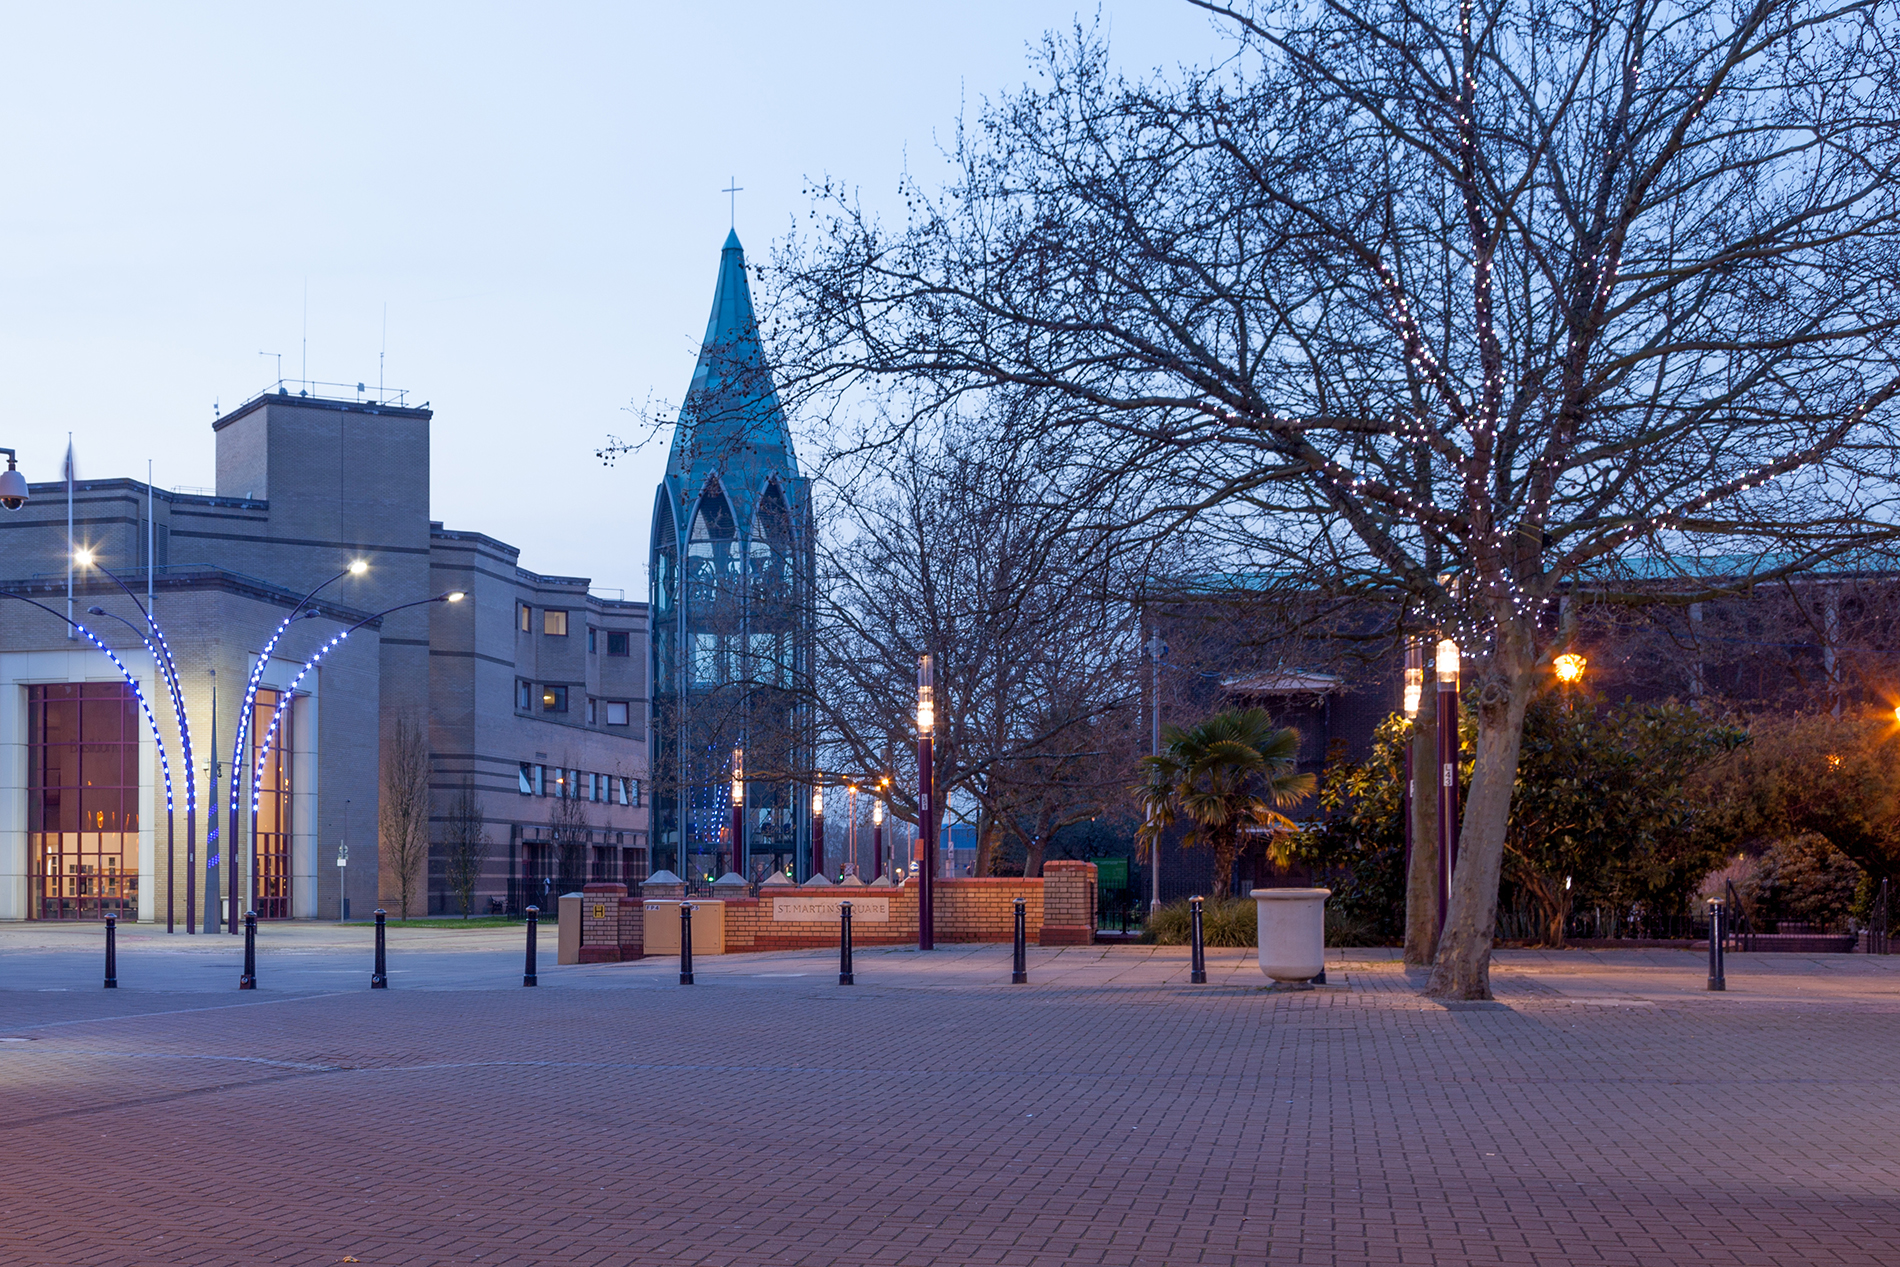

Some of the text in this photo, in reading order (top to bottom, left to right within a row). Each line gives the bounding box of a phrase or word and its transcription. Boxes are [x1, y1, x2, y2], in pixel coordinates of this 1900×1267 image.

[594, 905, 604, 917] H
[778, 903, 886, 915] ST. MARTIN'S QUARE
